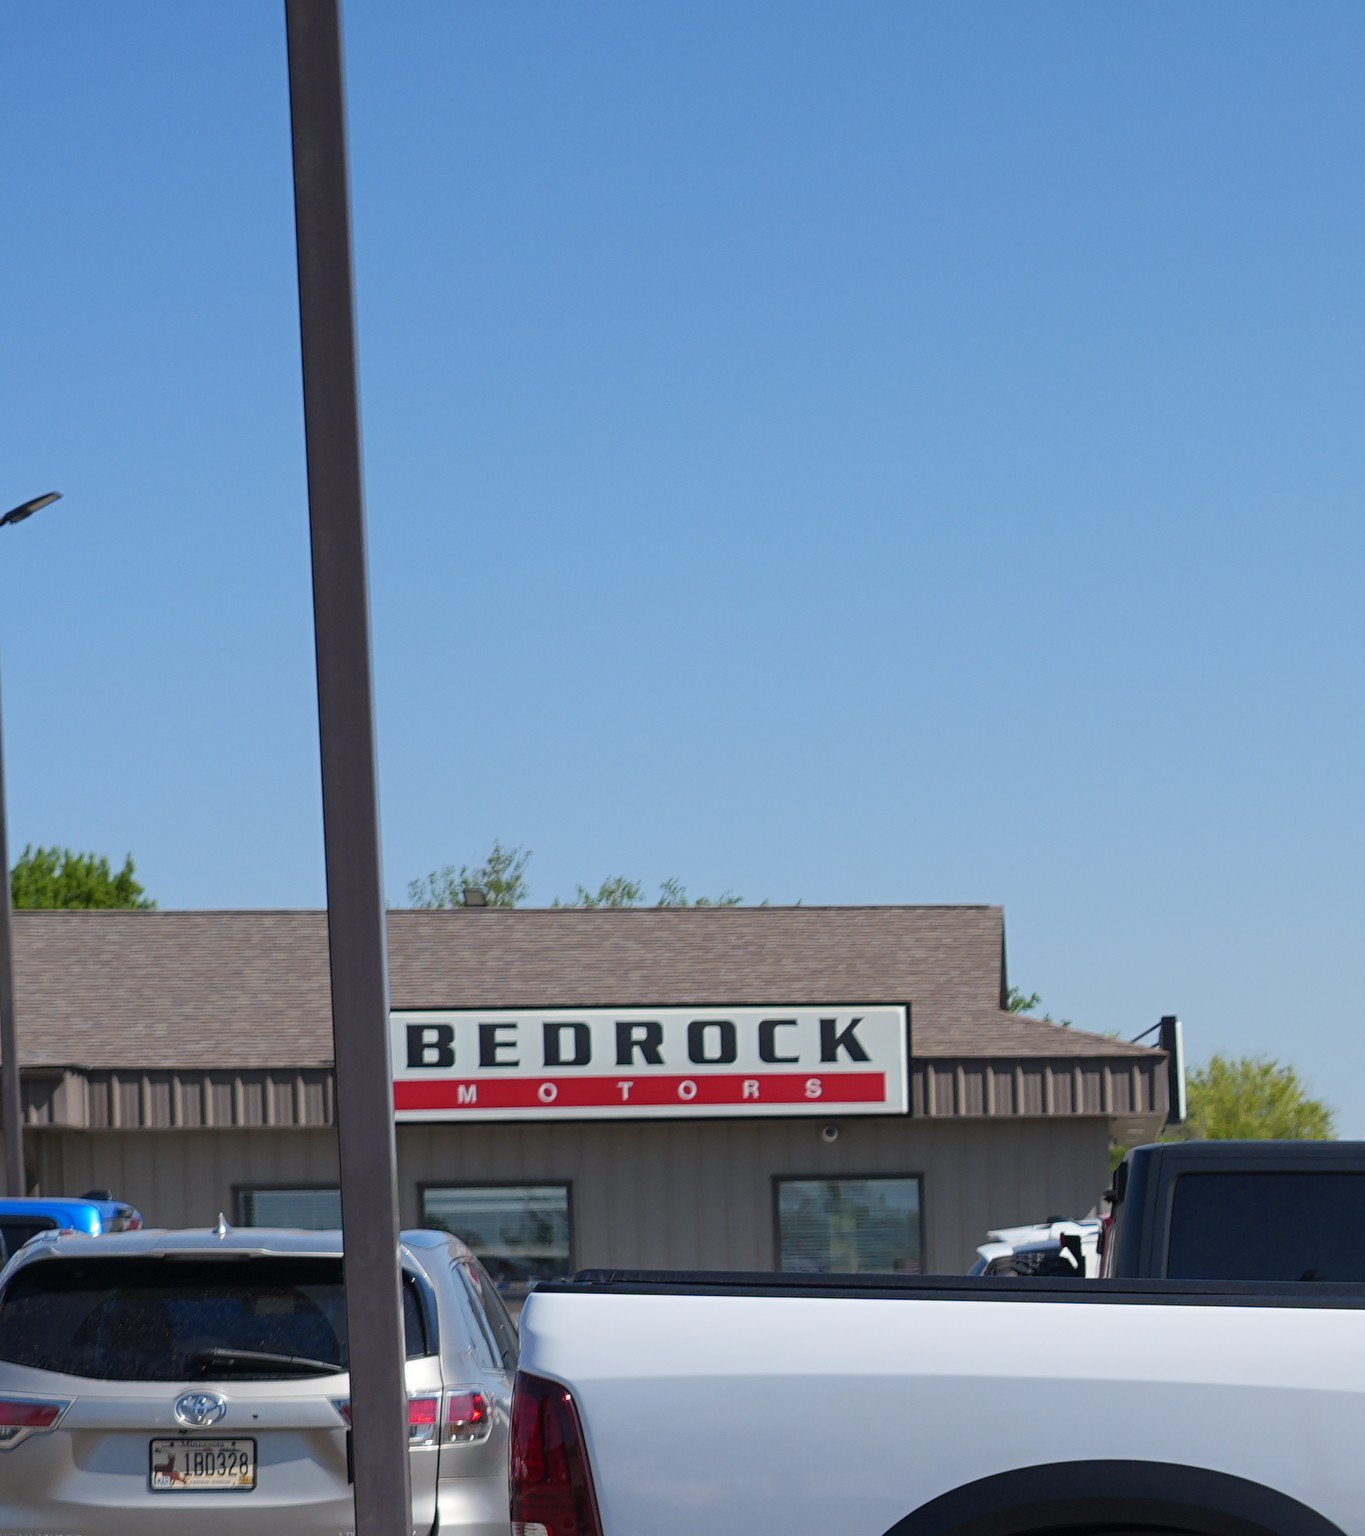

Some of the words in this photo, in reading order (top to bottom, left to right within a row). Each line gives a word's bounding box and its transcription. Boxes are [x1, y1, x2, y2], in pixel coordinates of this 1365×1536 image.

[406, 1017, 873, 1069] BEDROCK
[457, 1078, 823, 1105] MOTORS
[184, 1452, 249, 1477] 1BD328
